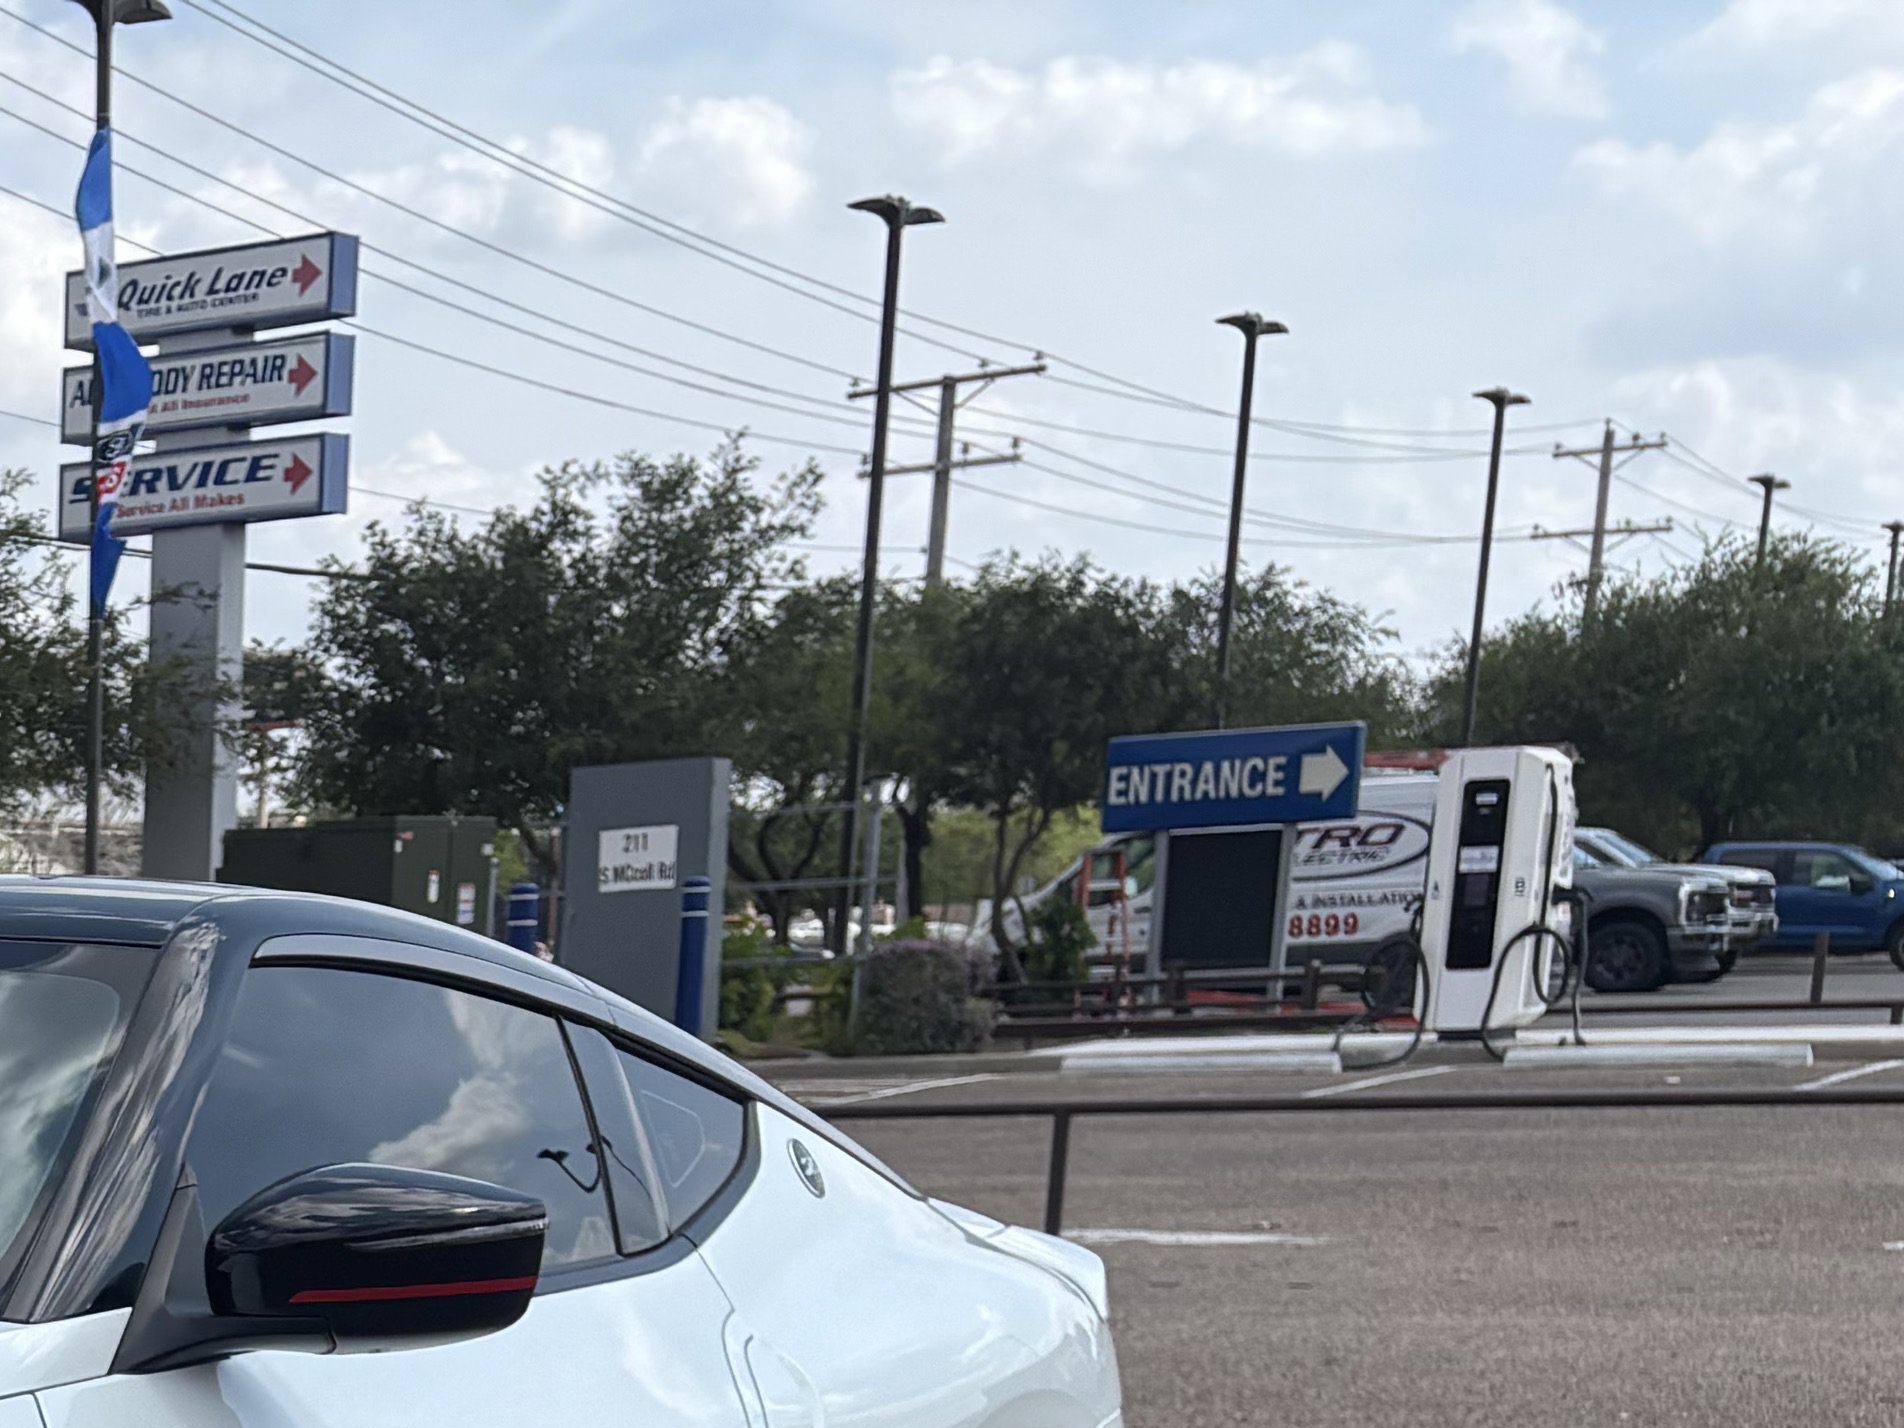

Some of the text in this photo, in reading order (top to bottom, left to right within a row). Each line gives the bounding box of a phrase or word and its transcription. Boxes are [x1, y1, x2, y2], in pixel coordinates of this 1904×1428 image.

[118, 266, 289, 311] Quick Lane
[137, 305, 161, 318] TIRE
[176, 299, 208, 312] AUTO
[211, 292, 260, 308] CENTER
[151, 354, 287, 397] ODY REPAIR
[181, 393, 251, 410] Insurance
[68, 453, 280, 504] SRVICE
[116, 493, 245, 518] Service All Makes
[1107, 755, 1289, 806] ENTRANCE
[622, 832, 649, 853] 211
